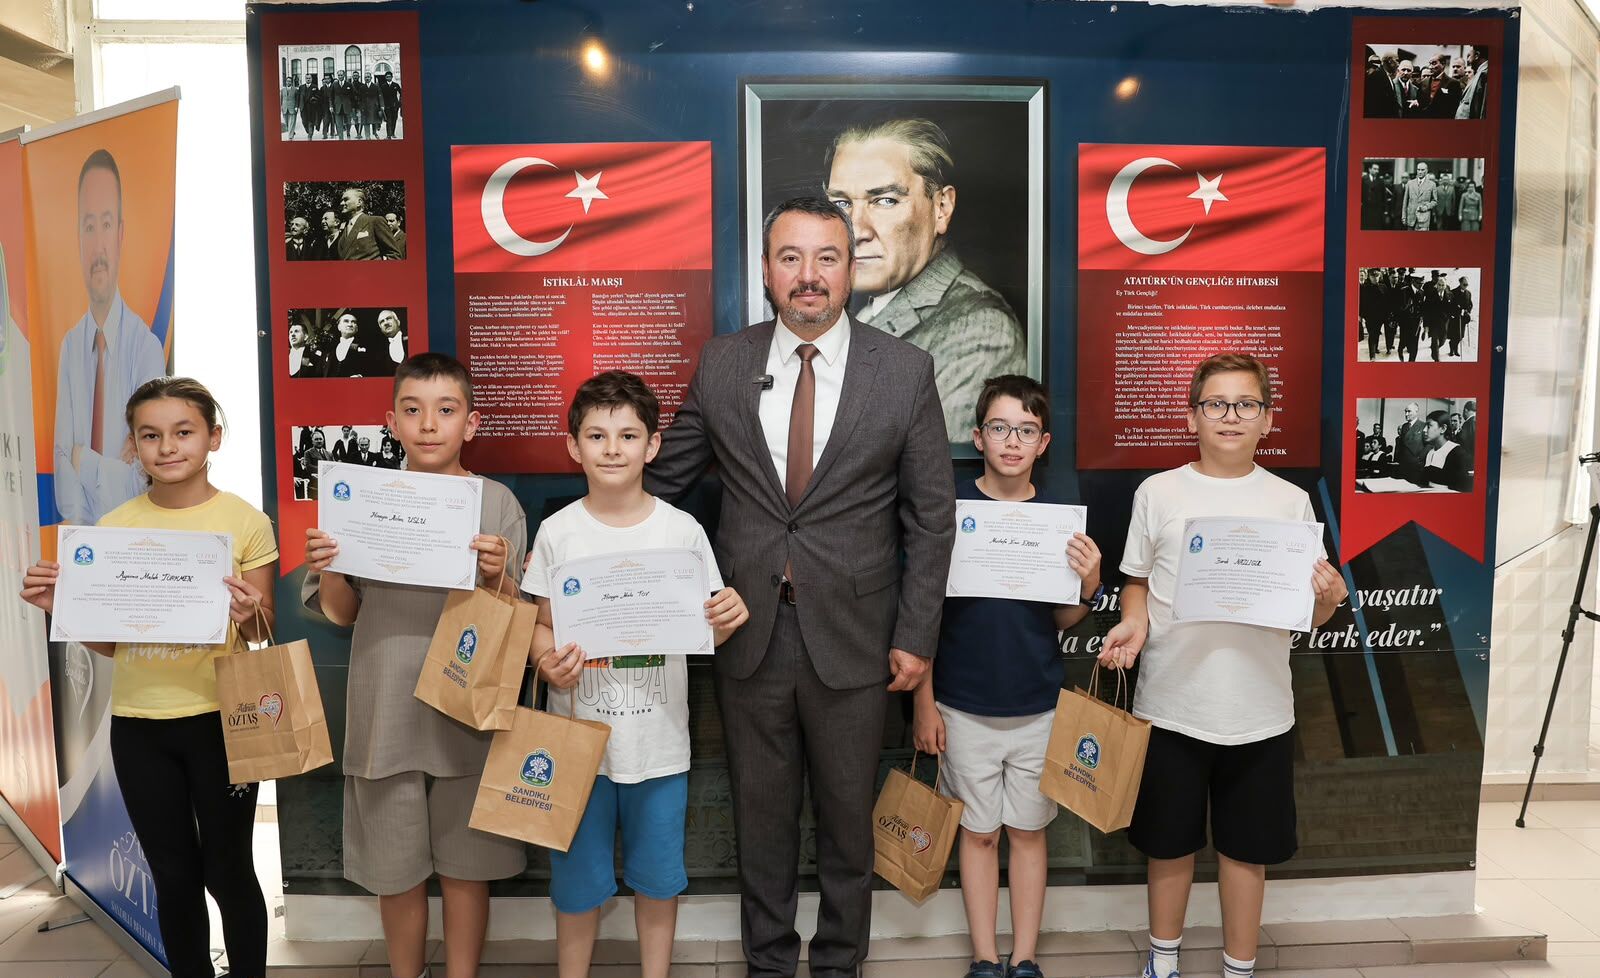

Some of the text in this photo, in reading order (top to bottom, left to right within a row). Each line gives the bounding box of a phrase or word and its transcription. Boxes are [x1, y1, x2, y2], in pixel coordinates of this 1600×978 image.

[543, 276, 623, 288] İSTİKLÂL MARŞI
[1124, 276, 1278, 288] ATATÜRK’ÜN GENÇLİĞE HİTABESİ
[1352, 584, 1443, 612] yaşatır
[1308, 624, 1360, 648] terk
[512, 786, 550, 802] SANDIKLI
[505, 794, 552, 812] BELEDİYESİ
